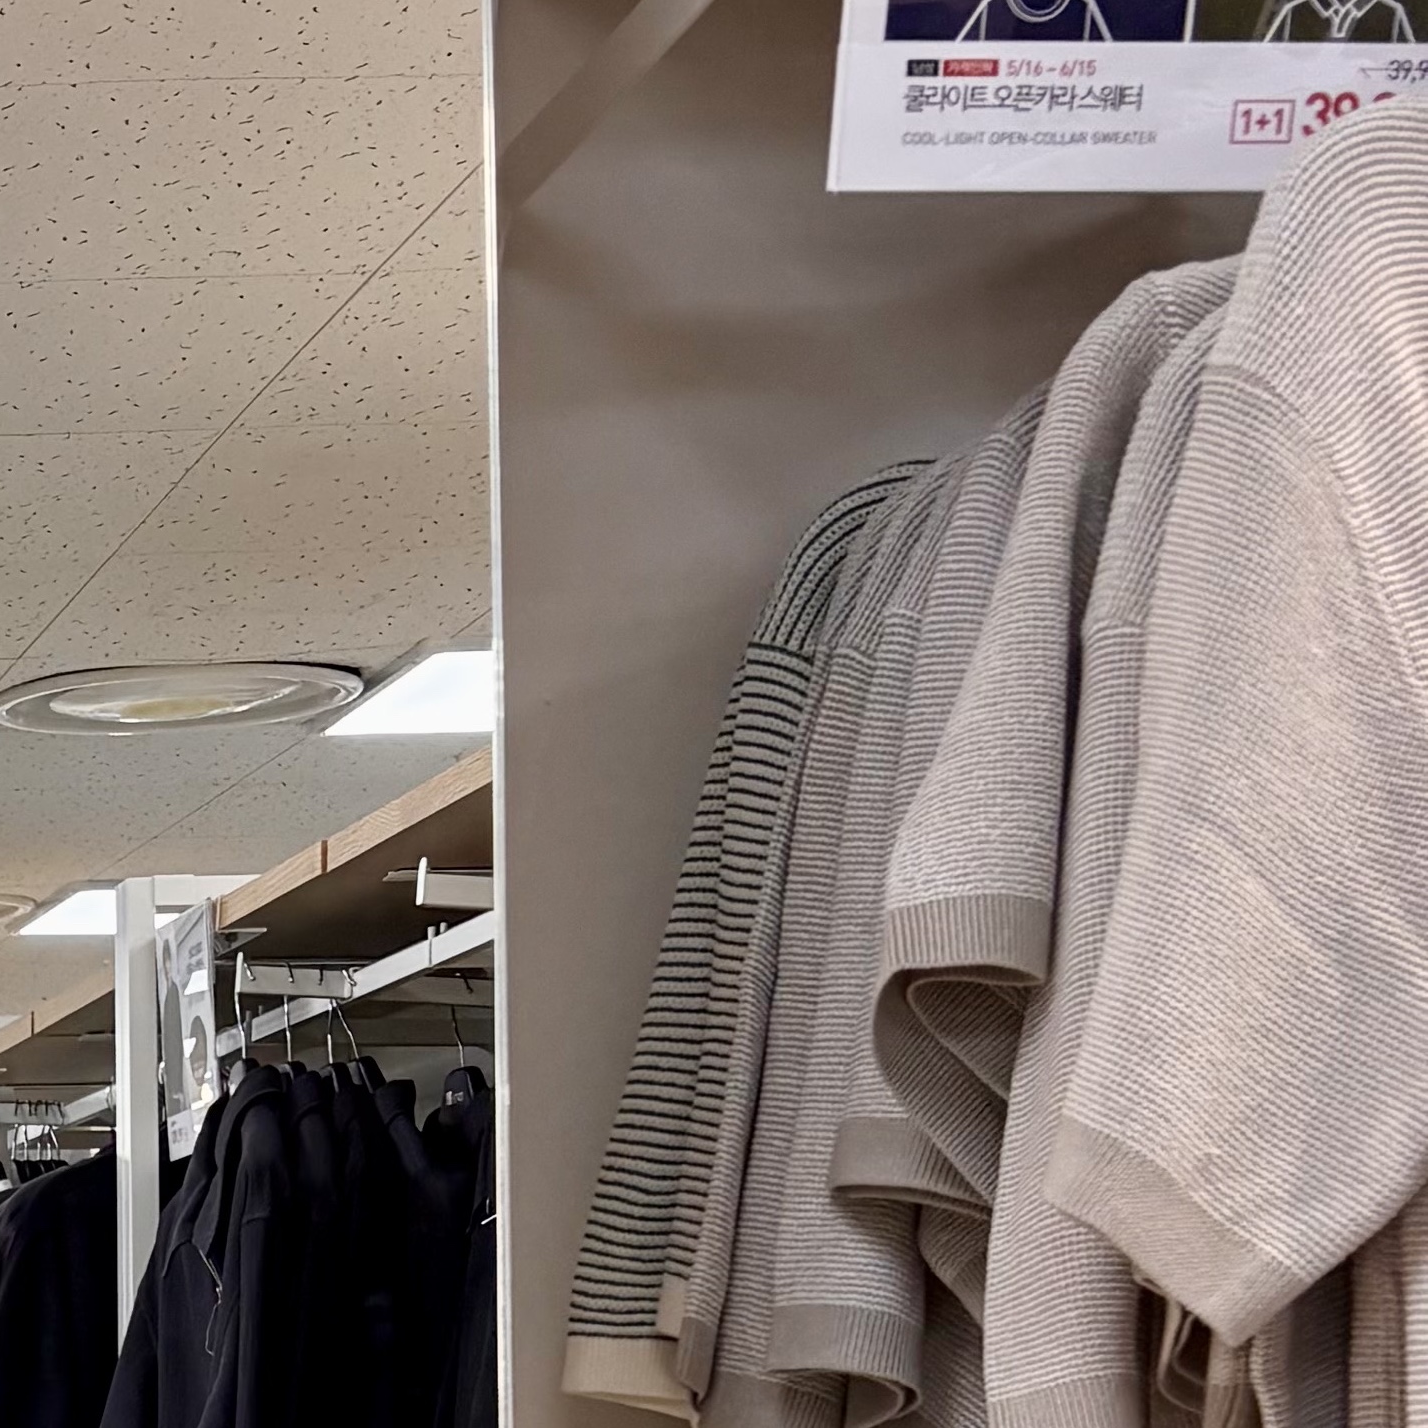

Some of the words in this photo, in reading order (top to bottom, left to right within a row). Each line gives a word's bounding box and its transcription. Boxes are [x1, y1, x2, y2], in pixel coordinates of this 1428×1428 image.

[1007, 60, 1043, 77] 5/16
[1060, 59, 1097, 76] 6/15
[903, 84, 989, 113] 쿨라이트
[995, 84, 1077, 113] 오픈카라
[1078, 84, 1144, 113] 스웨터
[1241, 107, 1286, 136] 1+1
[1090, 130, 1157, 145] SWEATER
